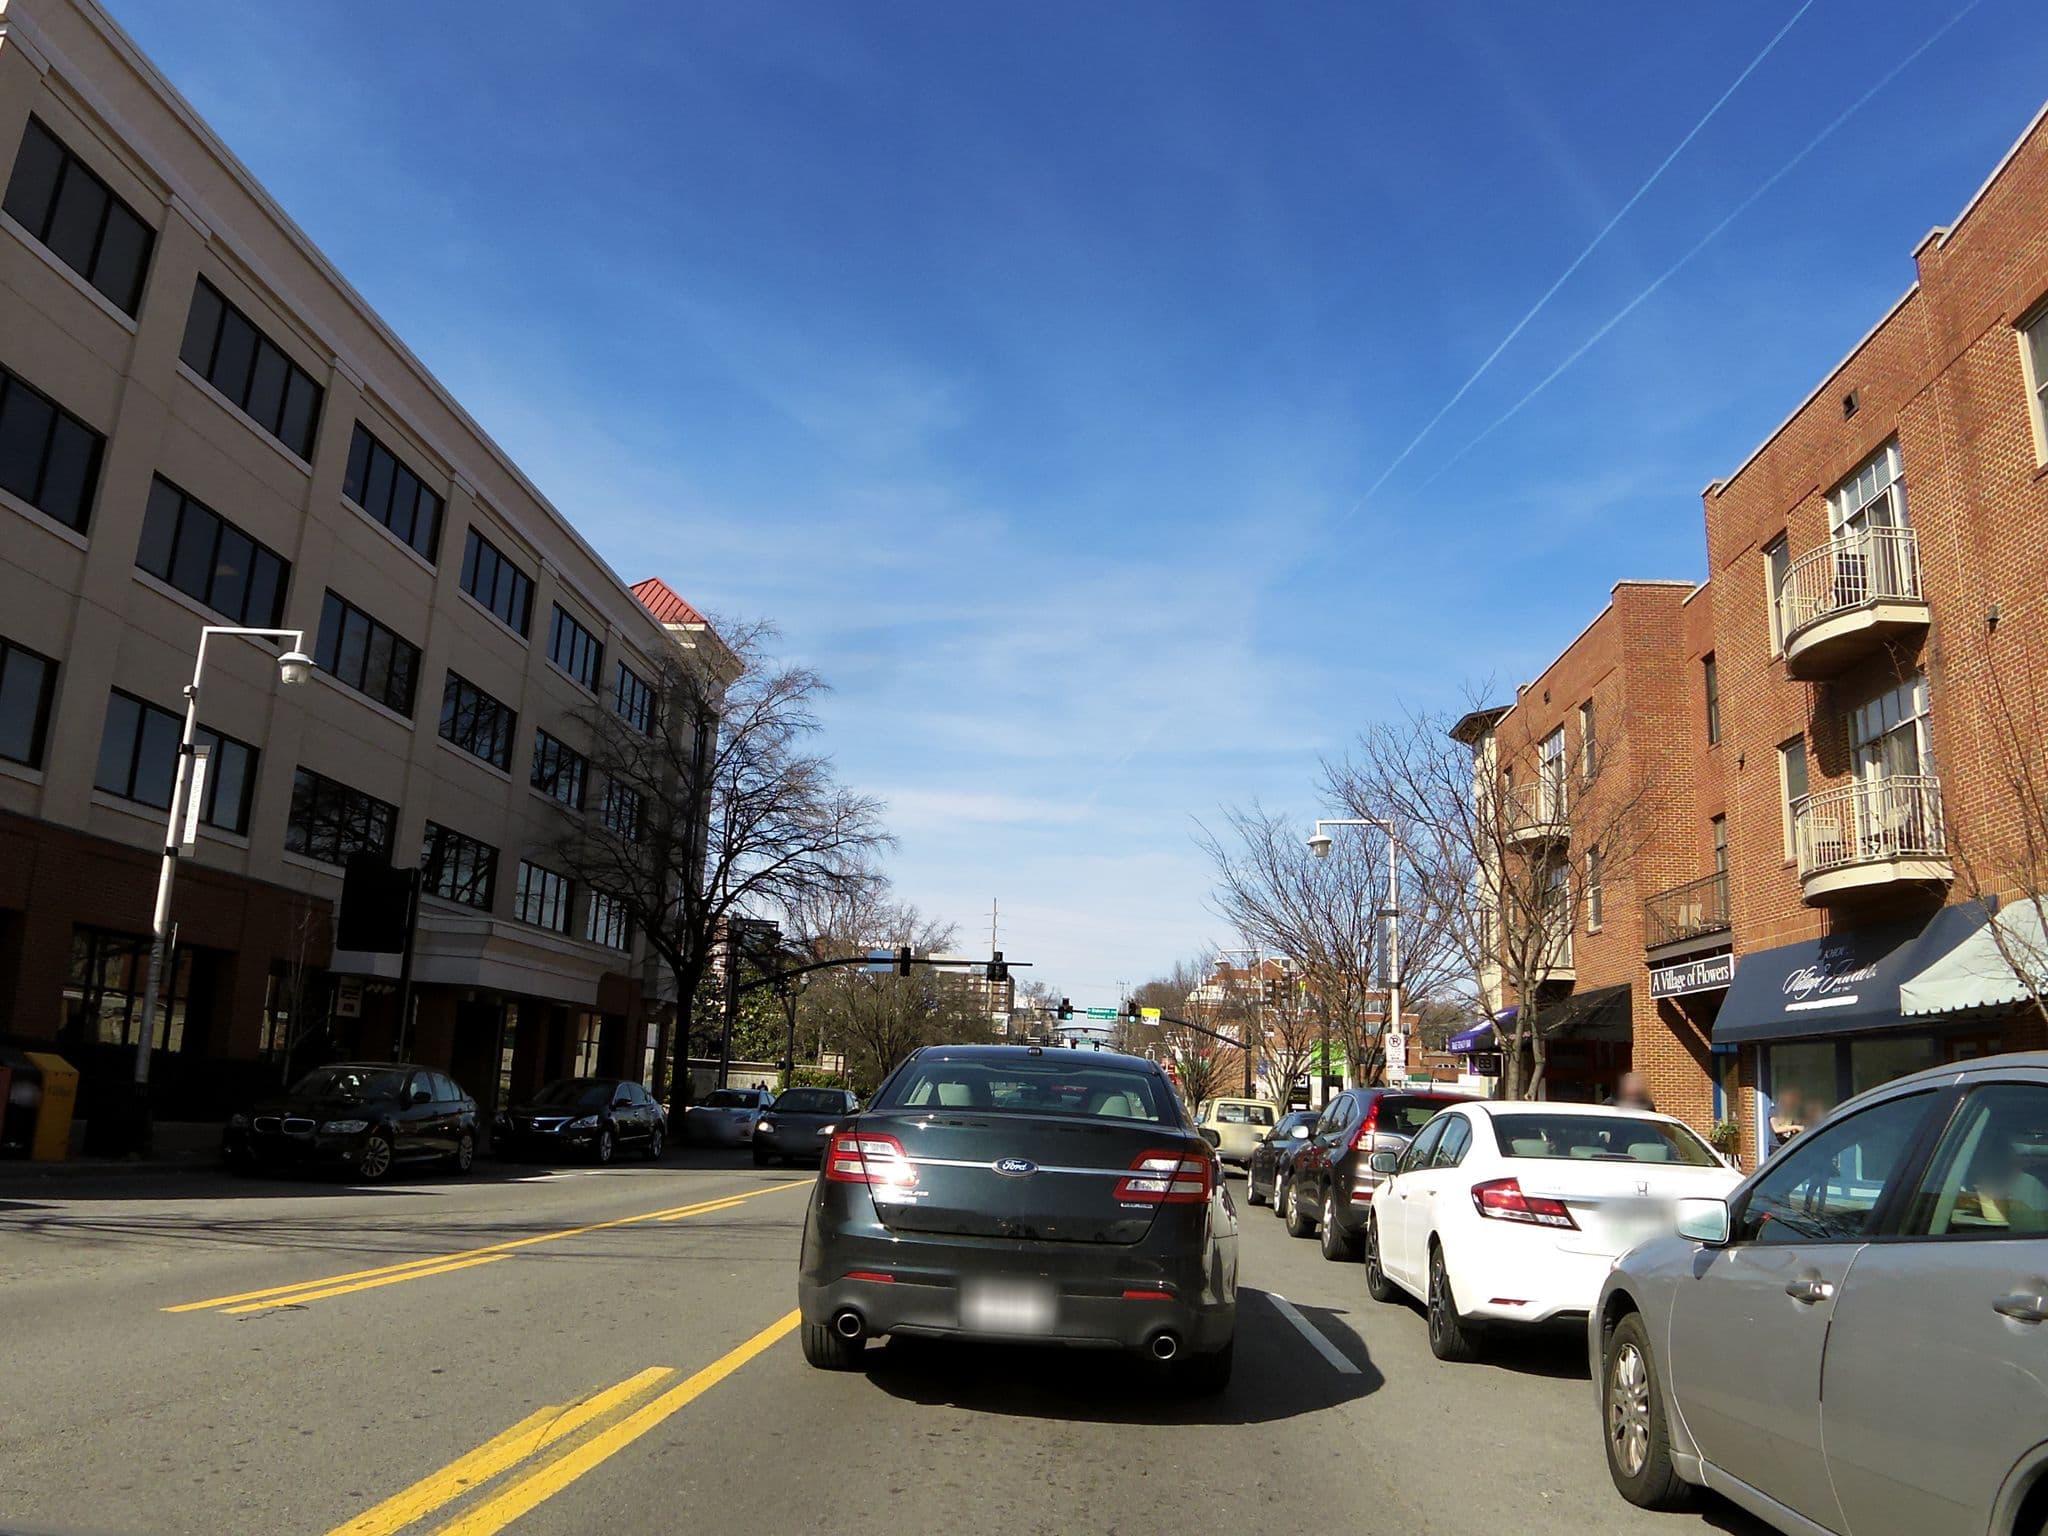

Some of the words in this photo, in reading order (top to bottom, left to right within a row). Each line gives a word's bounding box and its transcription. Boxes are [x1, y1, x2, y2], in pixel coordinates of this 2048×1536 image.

[1652, 973, 1660, 992] A
[1661, 970, 1686, 993] Village
[1687, 965, 1696, 986] of
[1696, 963, 1729, 985] Flowers
[1002, 1160, 1027, 1171] Ford
